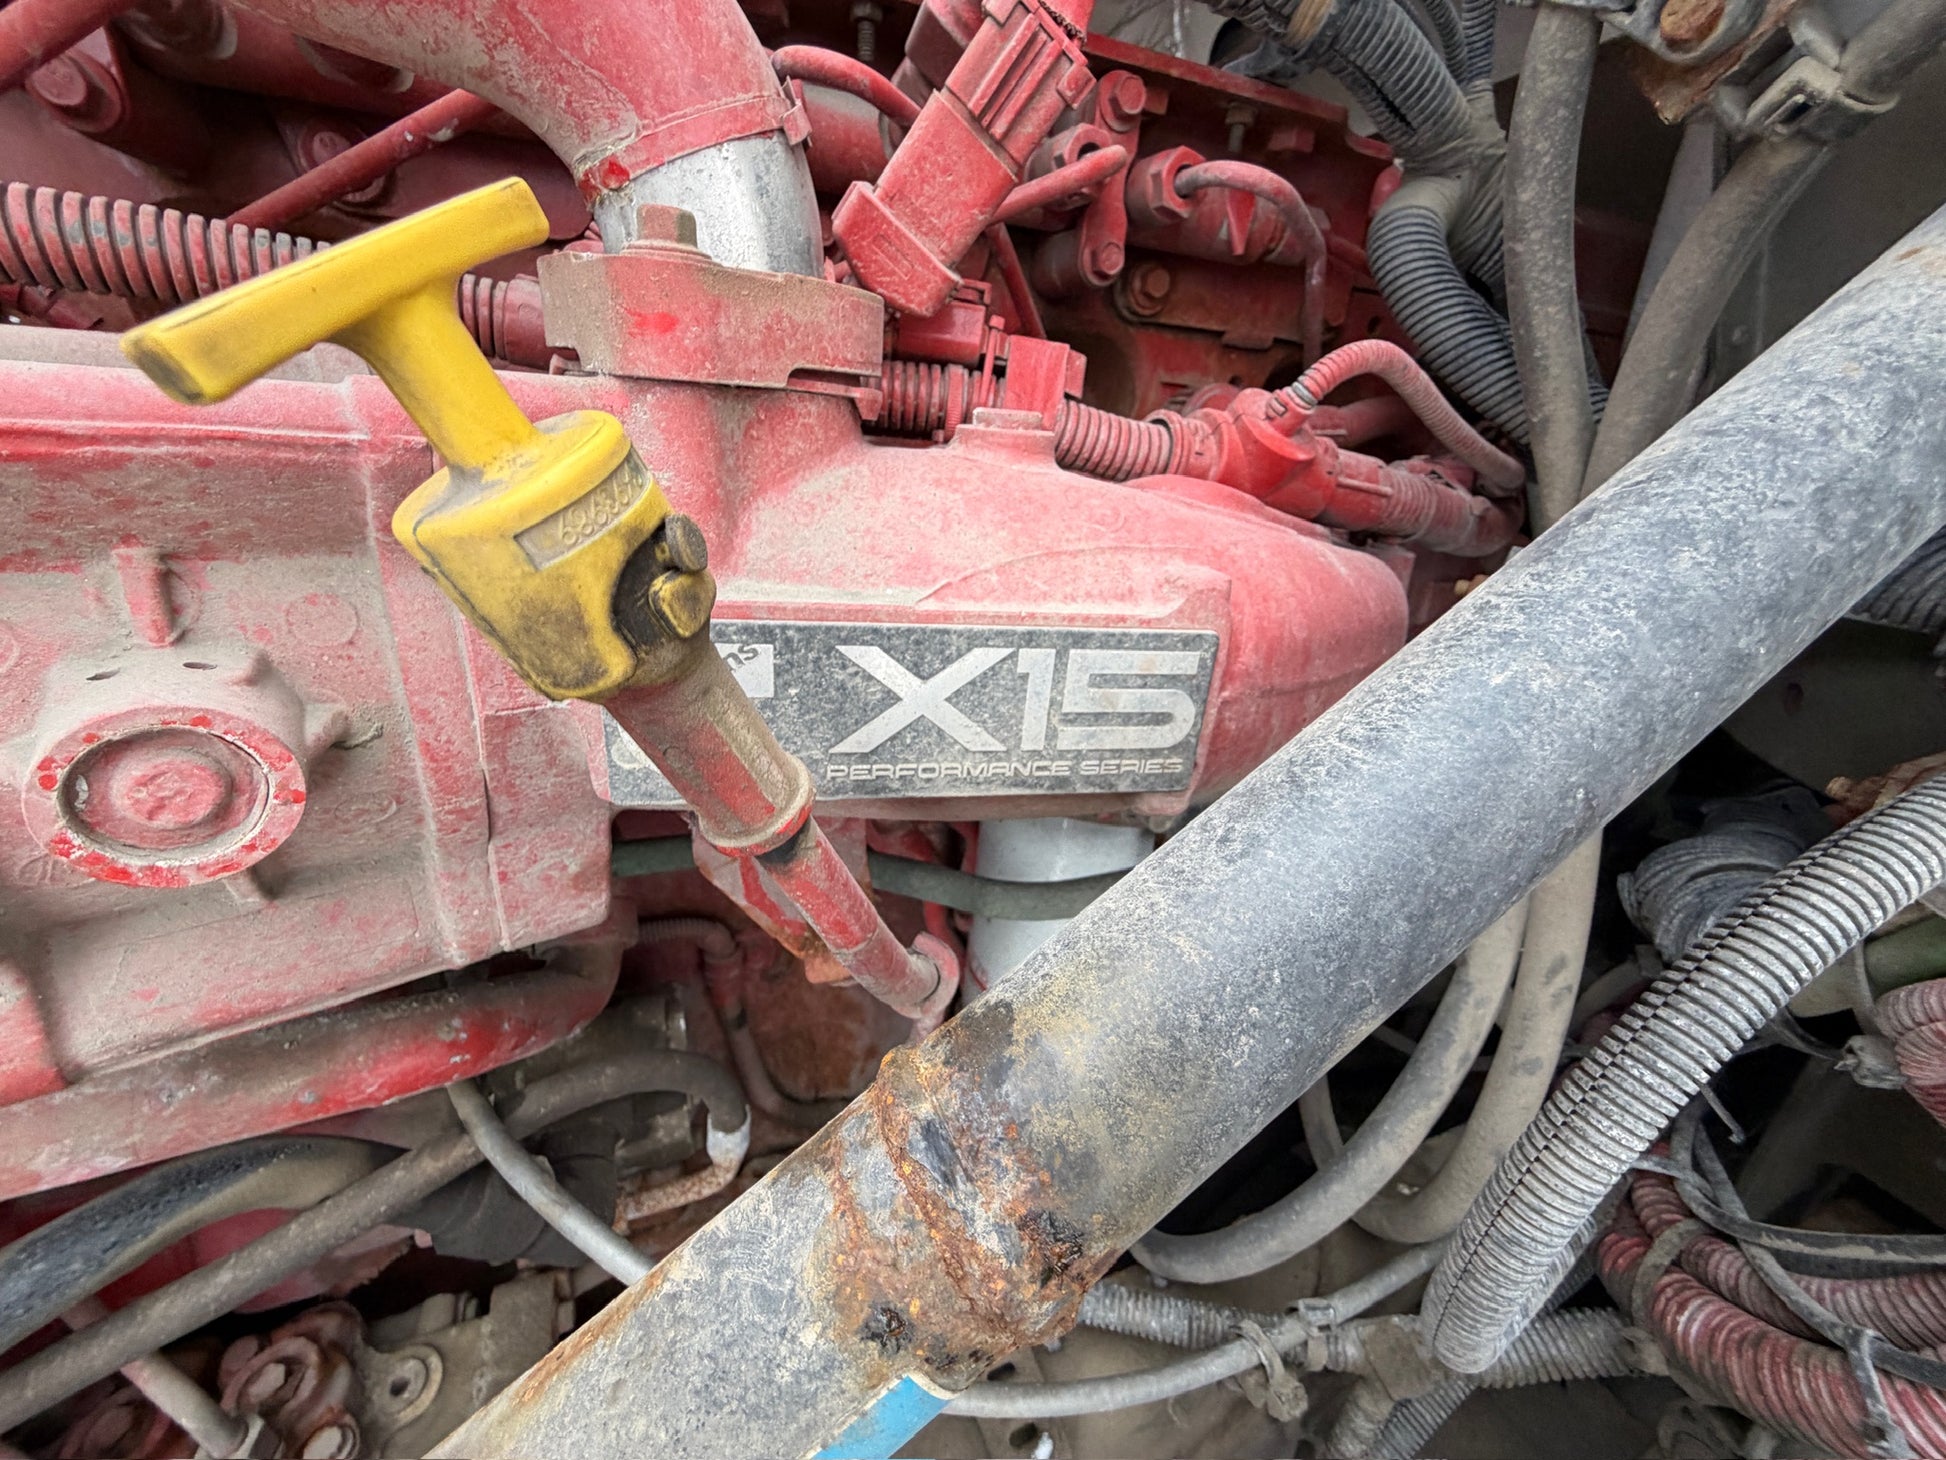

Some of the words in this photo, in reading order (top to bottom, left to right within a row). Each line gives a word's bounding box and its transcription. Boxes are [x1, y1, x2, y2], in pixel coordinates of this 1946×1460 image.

[829, 645, 1200, 753] X15
[826, 761, 1073, 781] PERFORMANCE
[1079, 758, 1184, 776] SERIES
